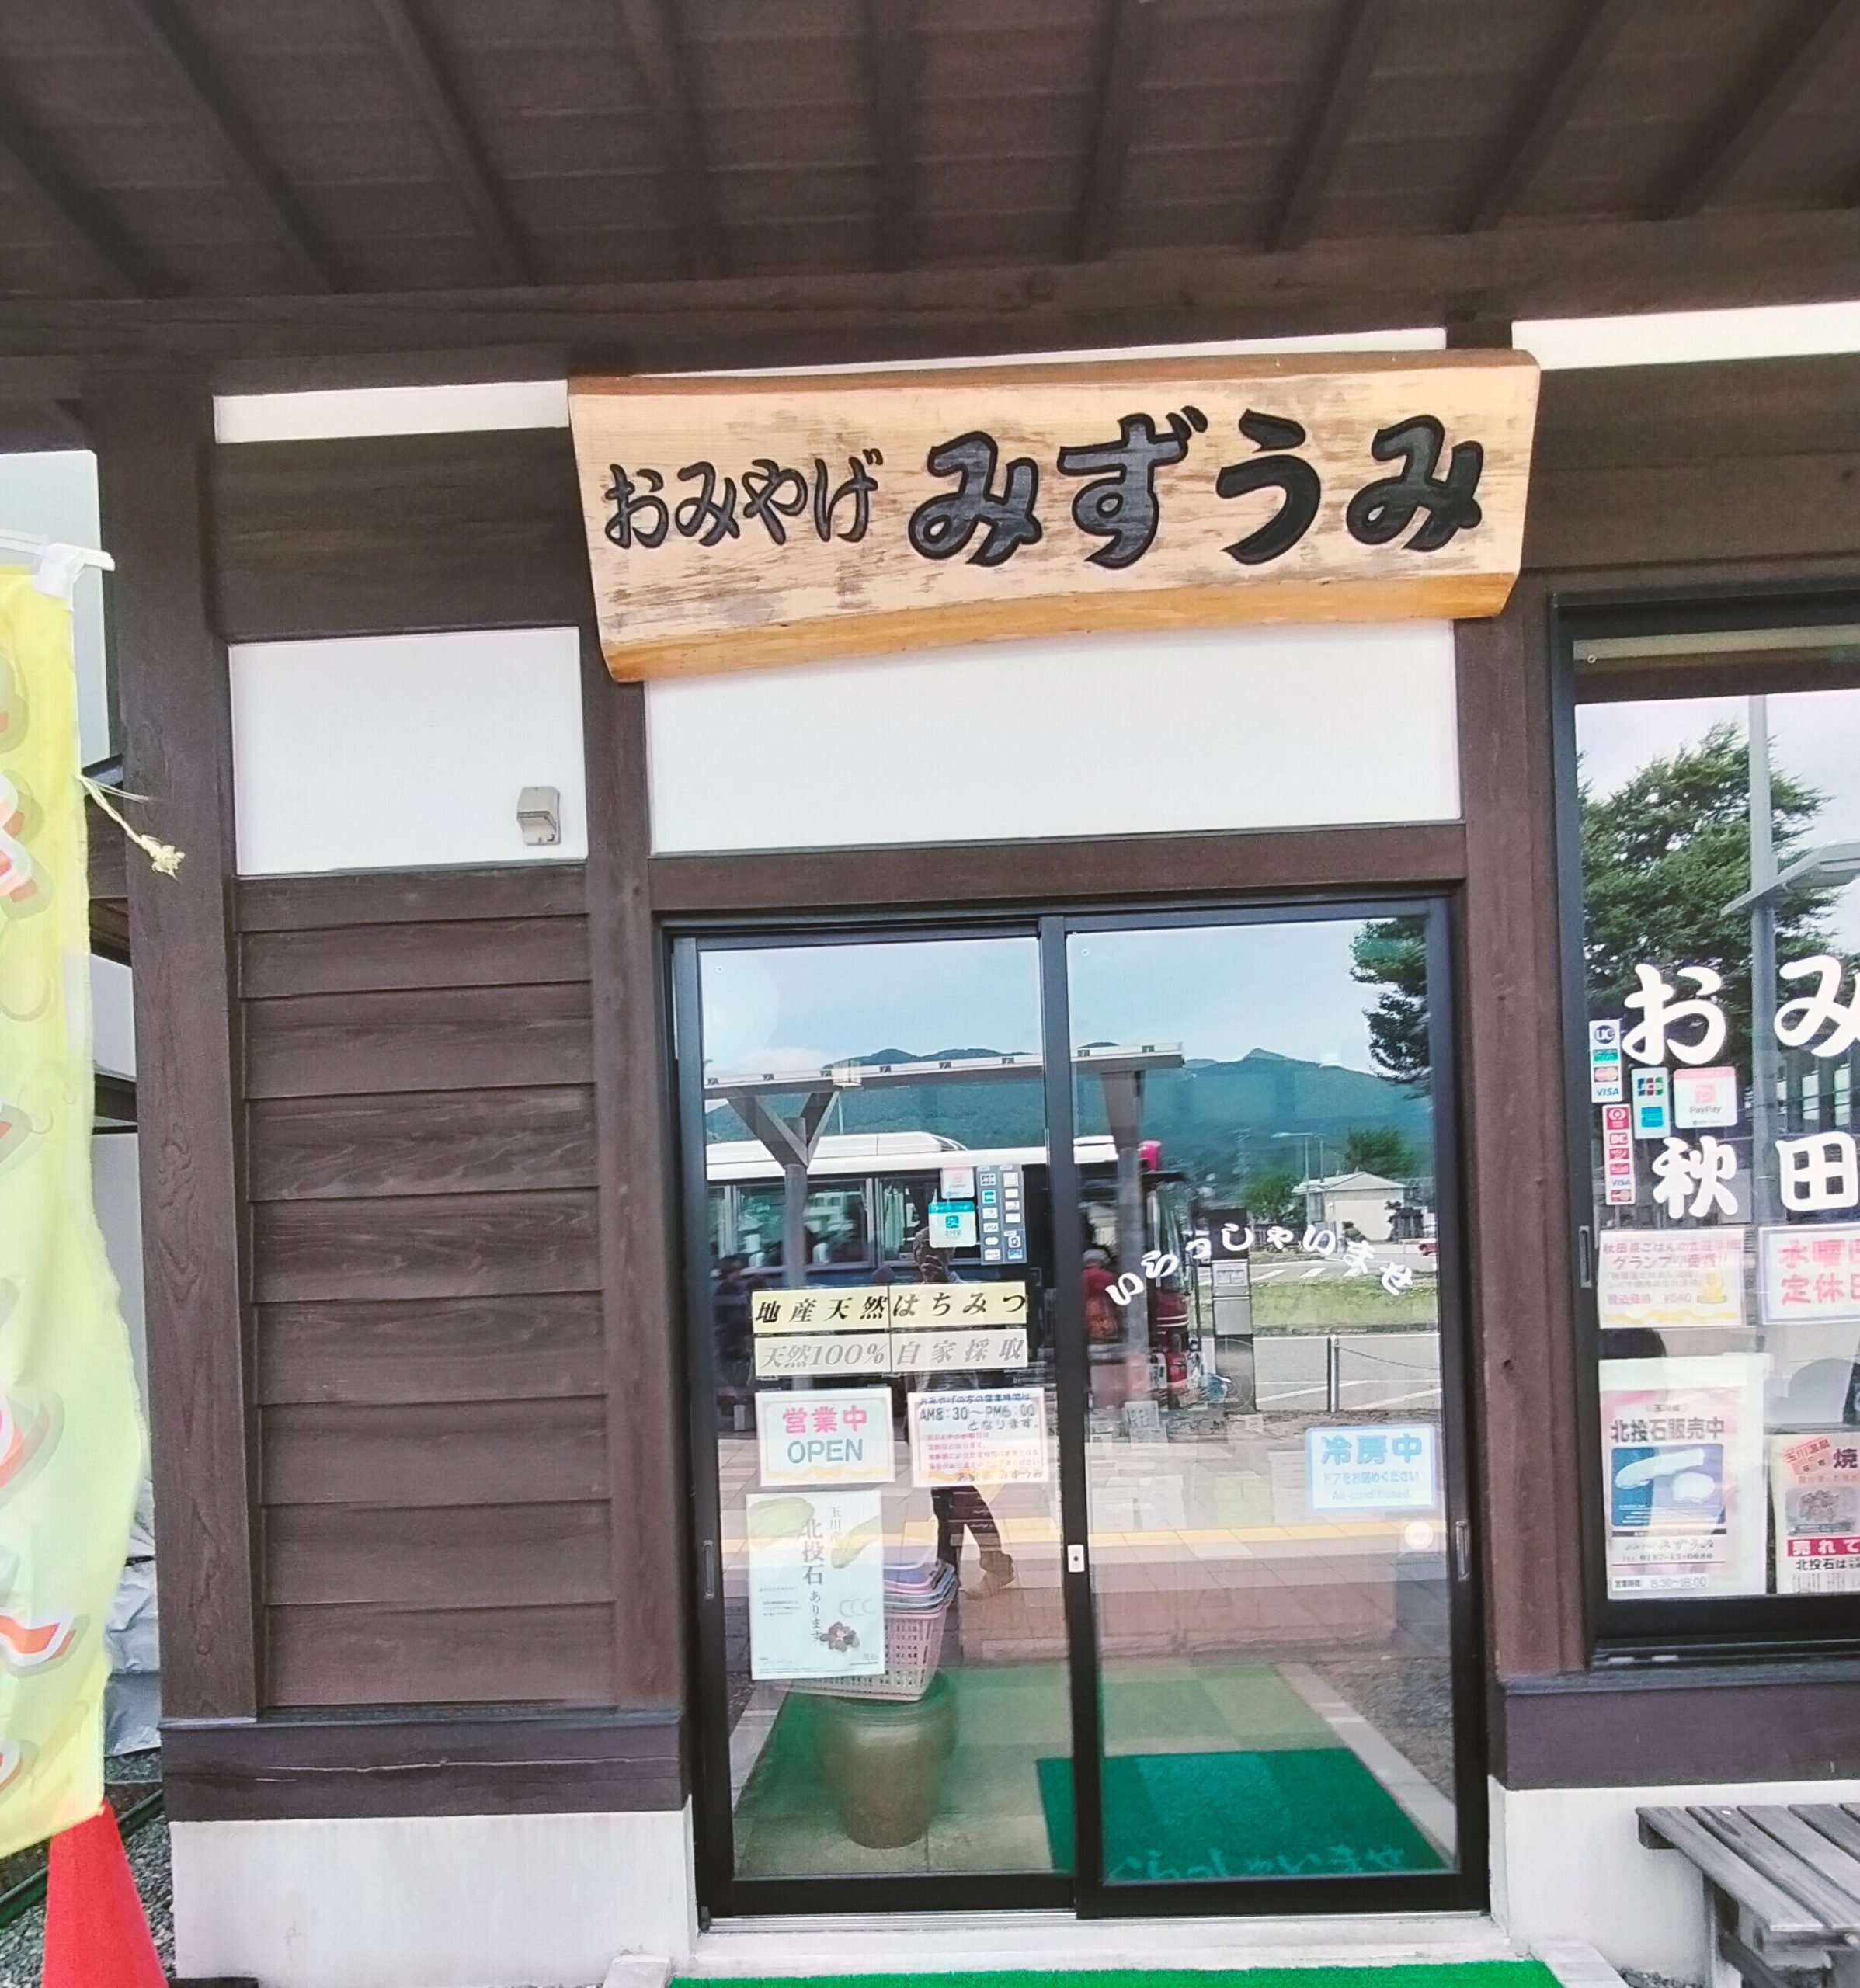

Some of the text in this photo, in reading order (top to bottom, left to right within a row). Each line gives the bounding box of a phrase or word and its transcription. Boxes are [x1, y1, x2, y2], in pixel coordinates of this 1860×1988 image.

[605, 405, 1486, 571] おみやげ みずうみ
[1597, 1087, 1619, 1096] VISA
[1105, 1222, 1413, 1306] いらっしゃいませ
[782, 1405, 867, 1434] 営業中
[1610, 1416, 1725, 1443] 北投石販売中
[787, 1440, 864, 1464] OPEN
[1321, 1434, 1423, 1465] 冷房中
